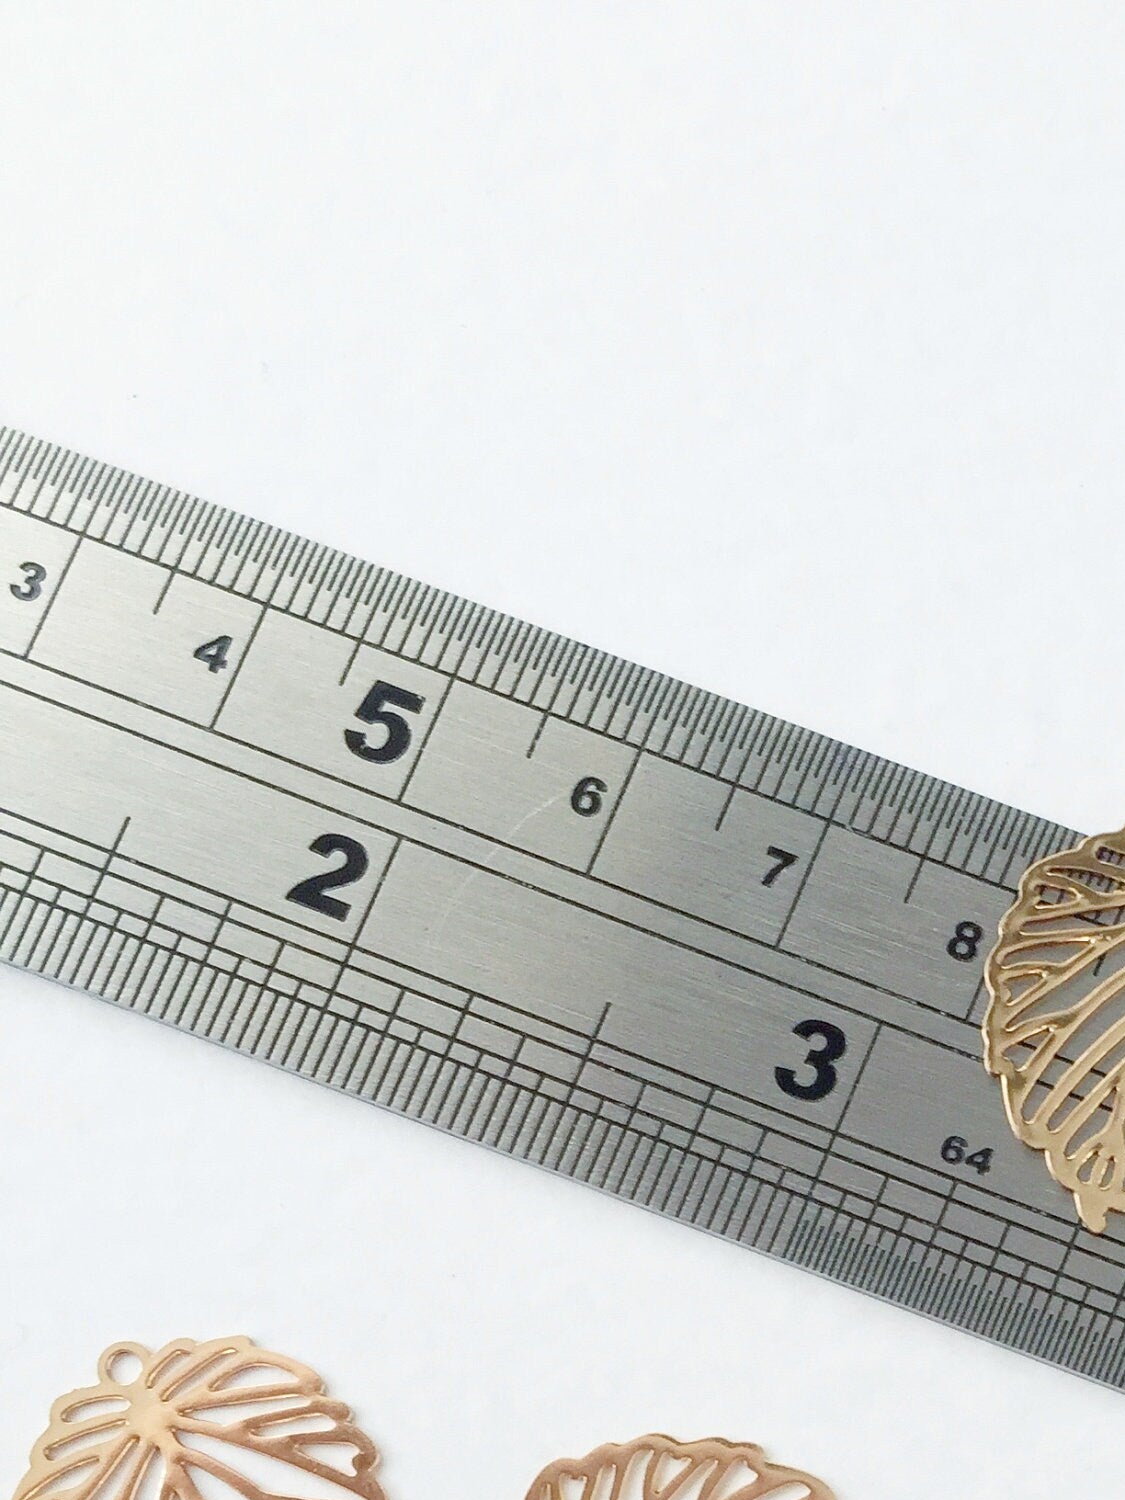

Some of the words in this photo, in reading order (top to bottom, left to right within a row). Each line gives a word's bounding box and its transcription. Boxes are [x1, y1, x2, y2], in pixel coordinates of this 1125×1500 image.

[9, 561, 47, 602] 3
[193, 634, 234, 674] 4
[343, 679, 426, 765] 5
[570, 776, 608, 817] 6
[760, 845, 800, 889] 7
[945, 920, 983, 963] 8
[284, 833, 369, 923] 2
[774, 1019, 848, 1103] 3
[940, 1135, 994, 1176] 64
